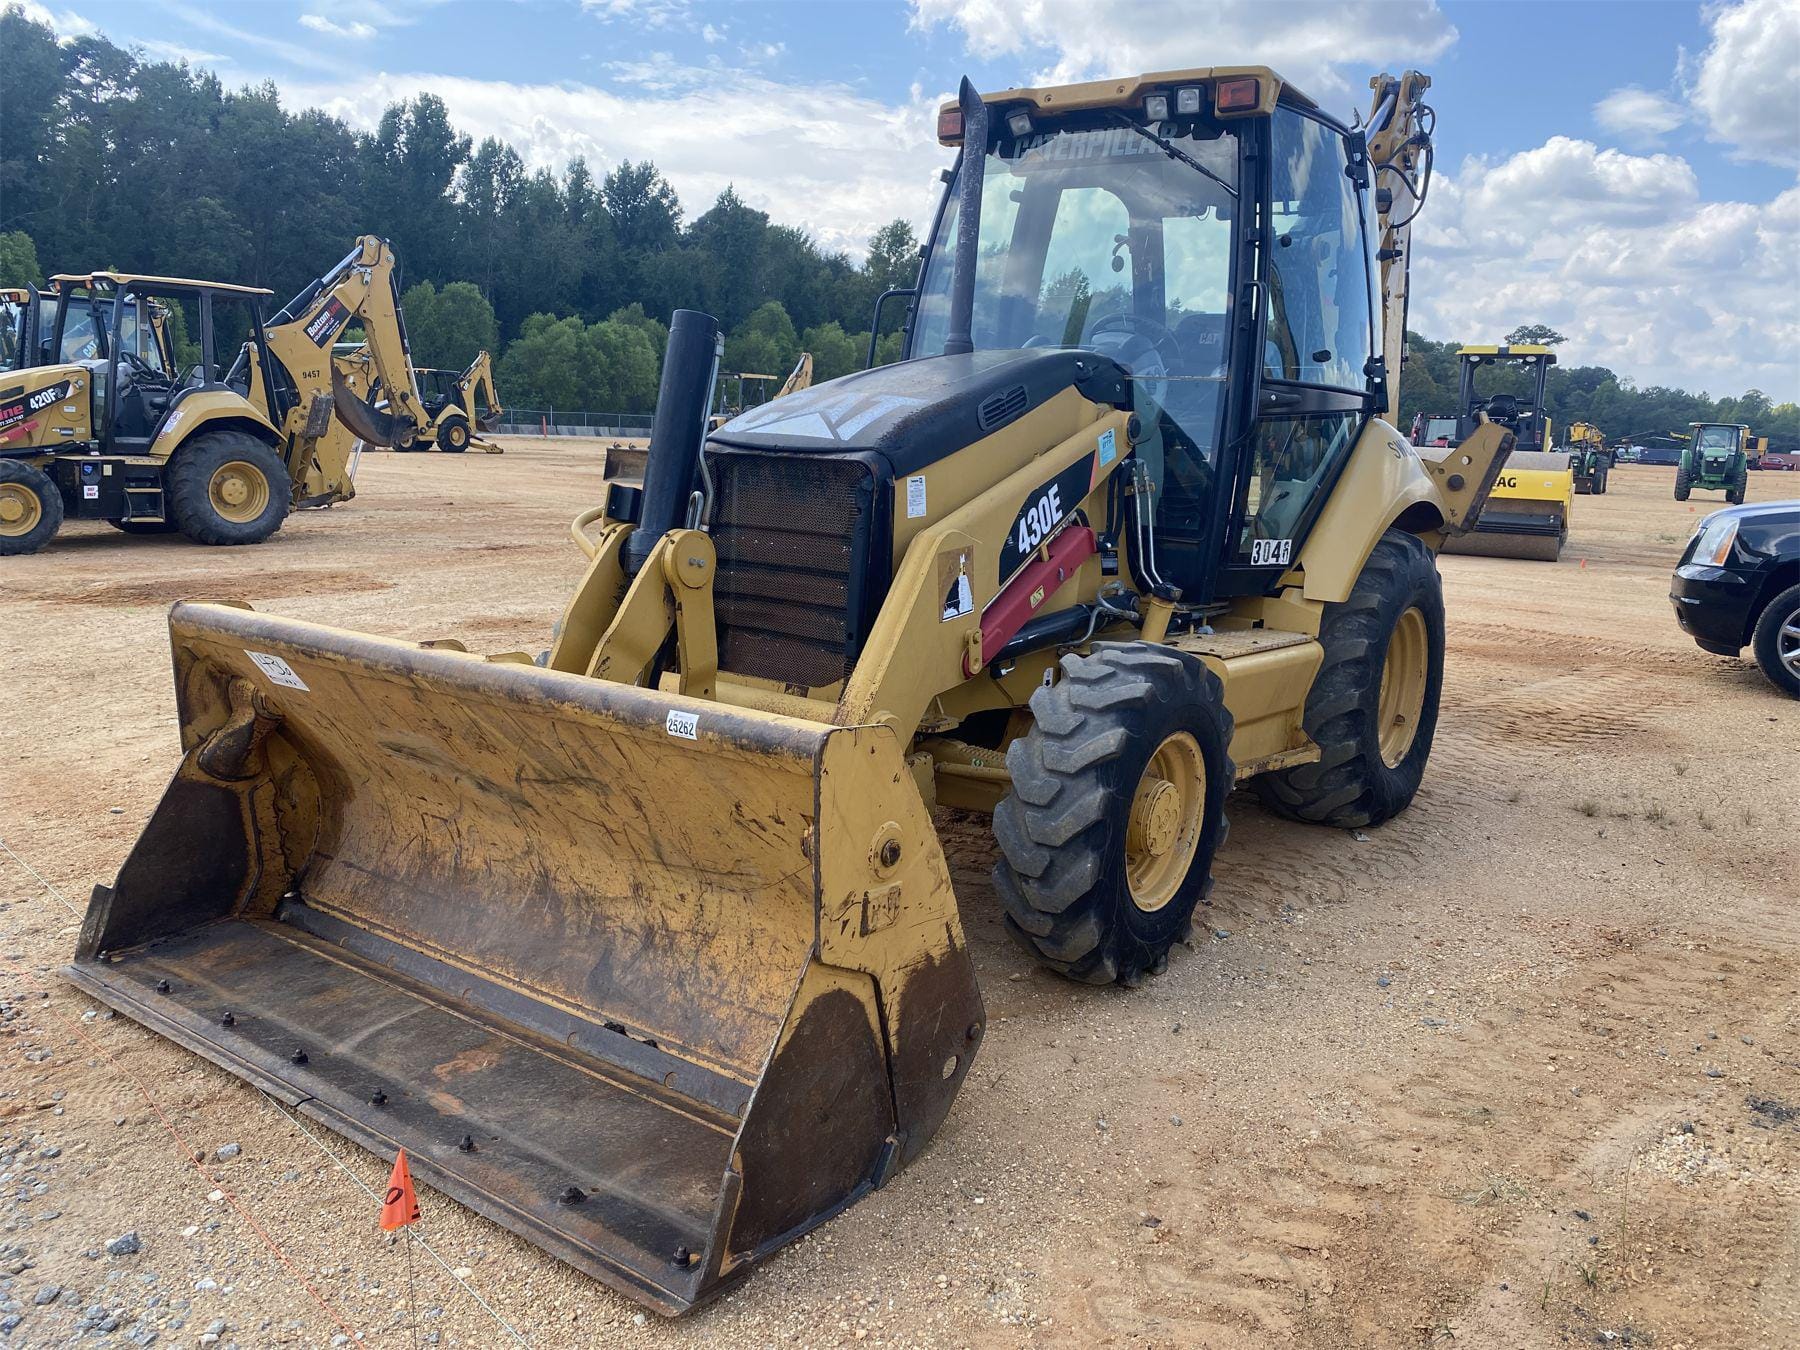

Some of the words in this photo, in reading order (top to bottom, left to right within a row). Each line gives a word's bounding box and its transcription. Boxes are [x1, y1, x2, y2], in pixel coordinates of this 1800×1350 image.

[1013, 121, 1179, 164] CATERPILLAR
[1019, 483, 1063, 554] 430E
[668, 719, 694, 737] 25262
